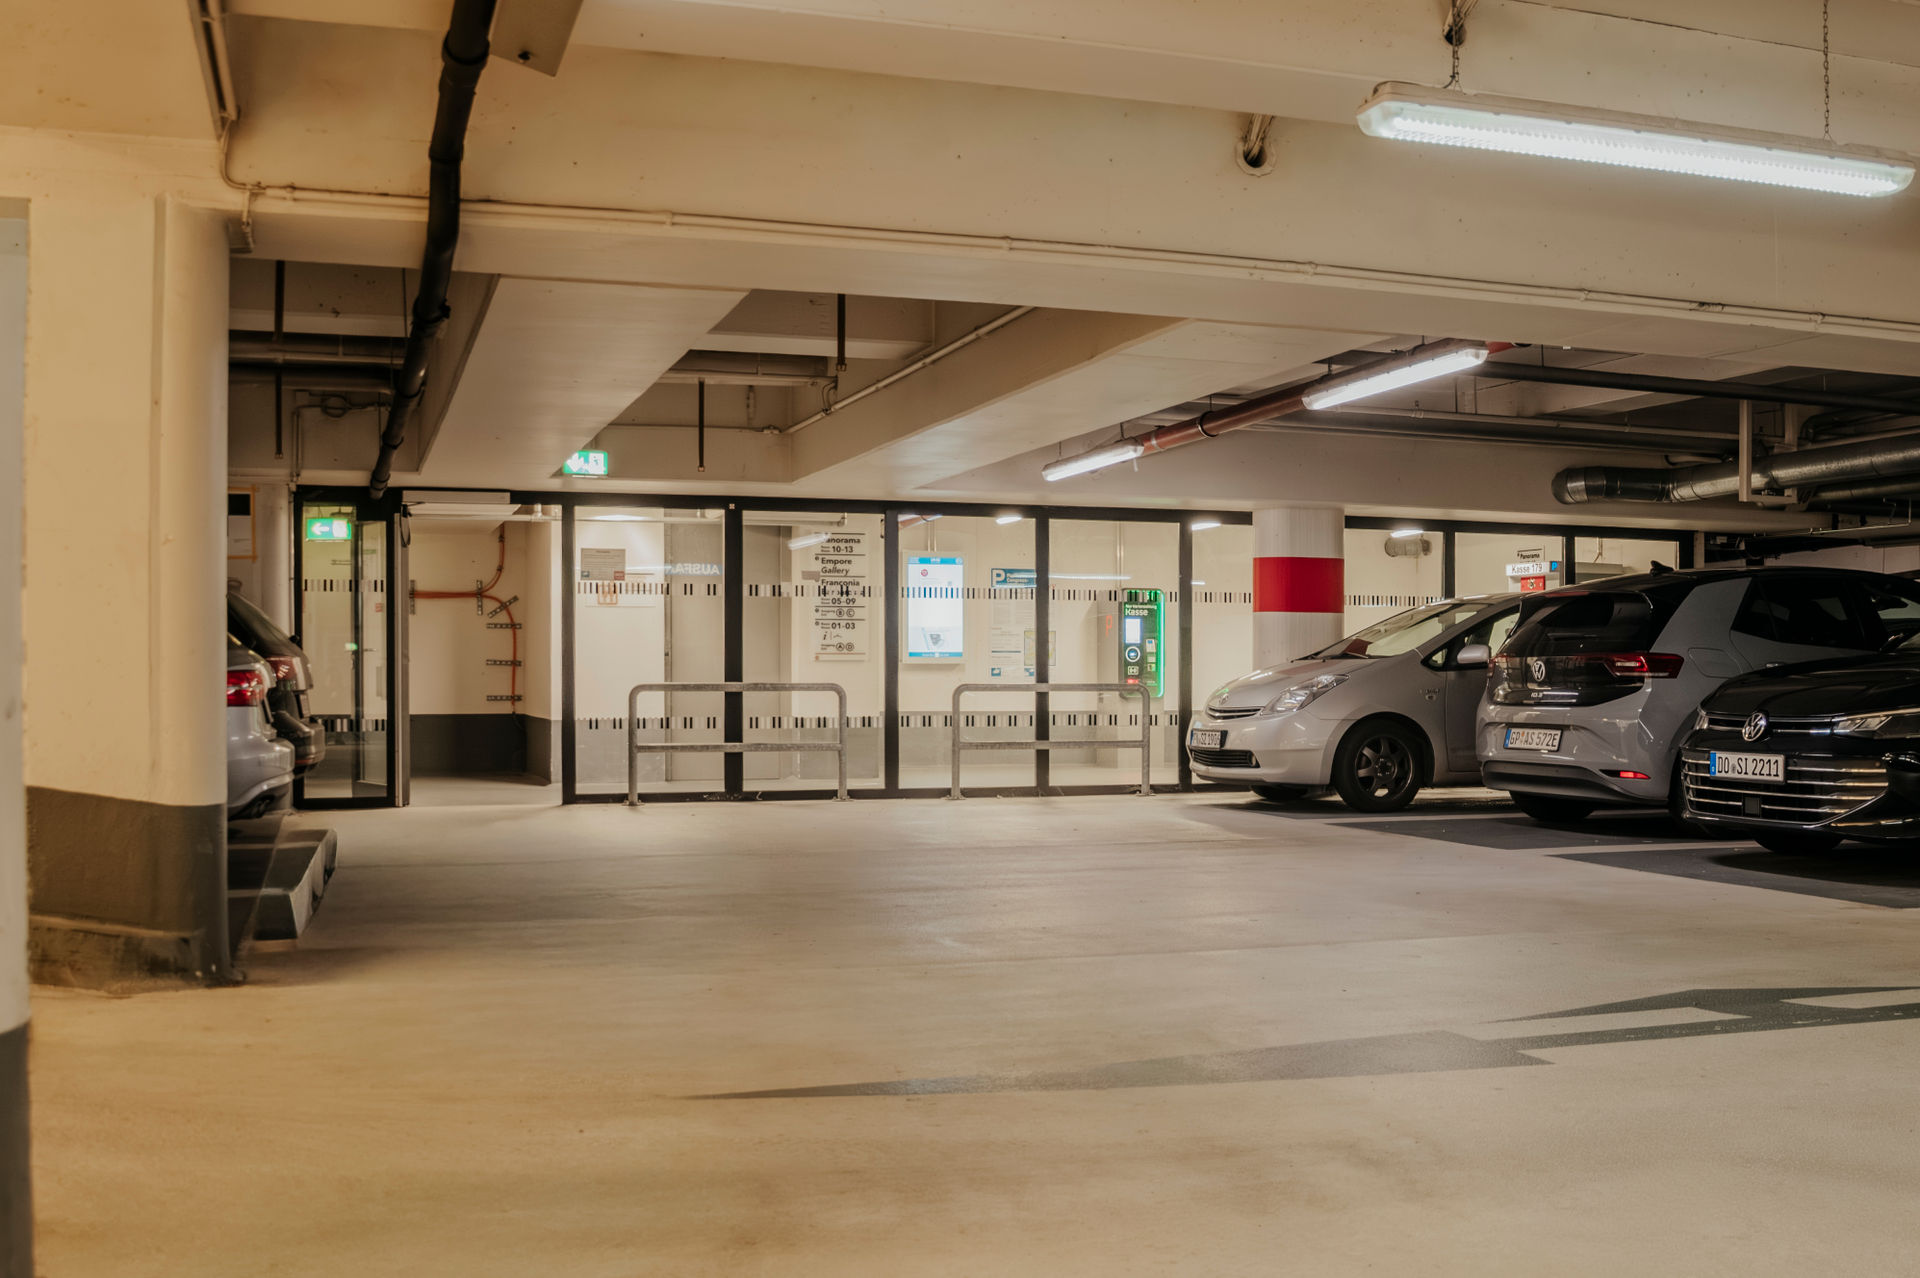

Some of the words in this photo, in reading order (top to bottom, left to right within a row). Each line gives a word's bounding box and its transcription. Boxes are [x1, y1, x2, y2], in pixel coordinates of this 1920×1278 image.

[832, 545, 854, 553] 10-13
[821, 557, 852, 566] Empore
[821, 566, 850, 577] Gallery
[1511, 566, 1530, 574] Kasse
[1532, 564, 1543, 572] 179
[1510, 731, 1521, 745] GP
[1522, 732, 1535, 746] AS
[1536, 732, 1558, 747] 572E
[1718, 756, 1730, 773] DO
[1737, 757, 1748, 775] SI
[1752, 758, 1779, 777] 2211
